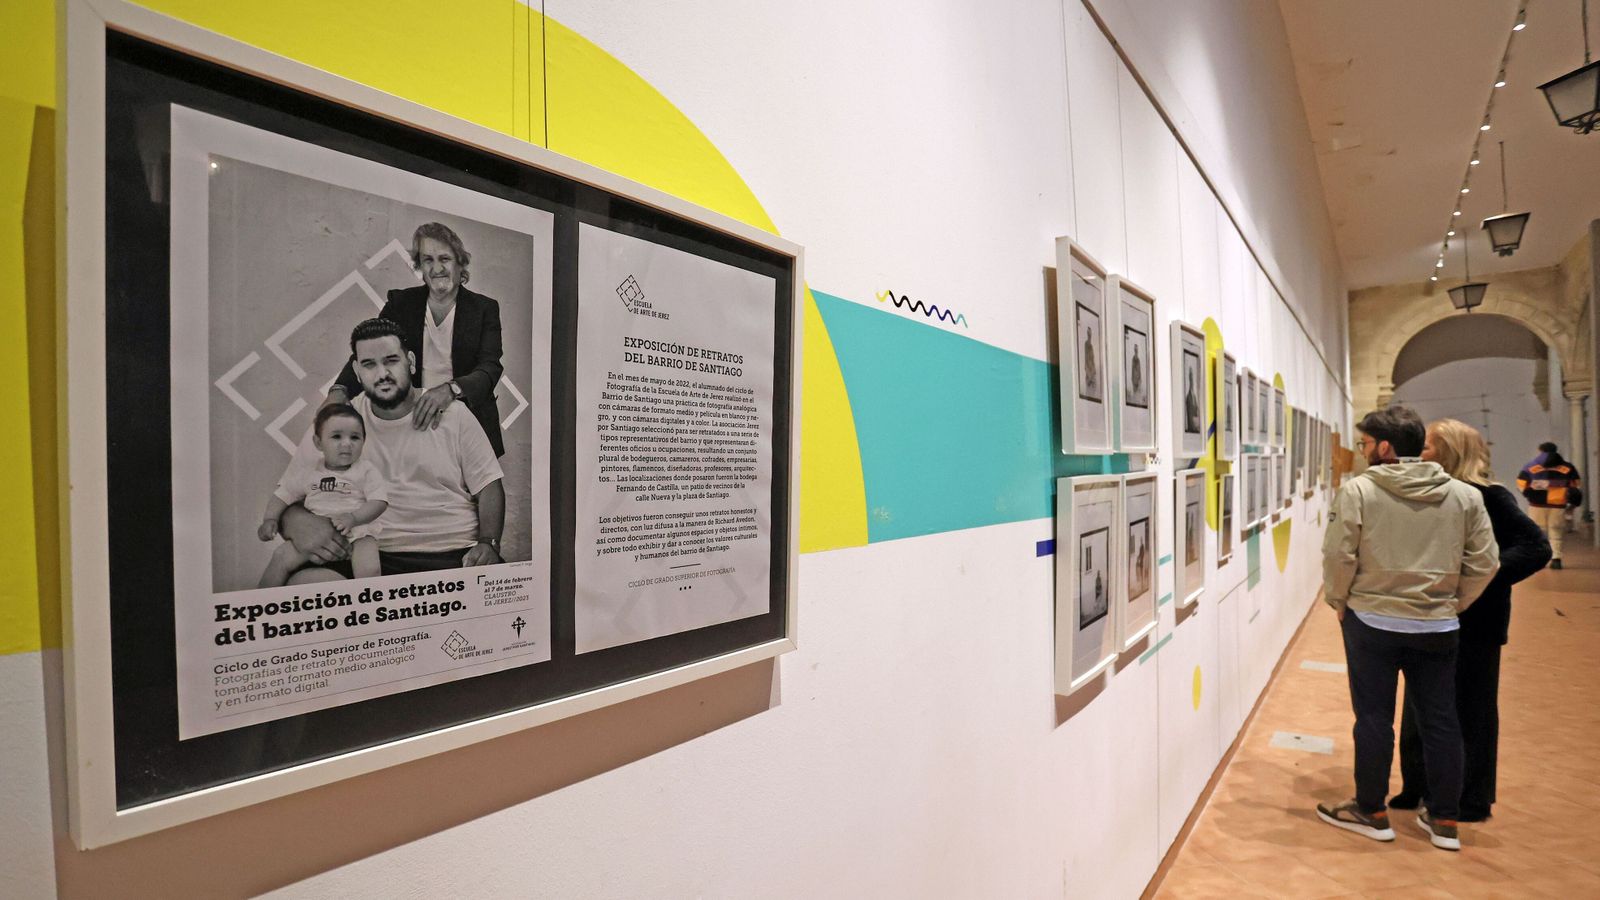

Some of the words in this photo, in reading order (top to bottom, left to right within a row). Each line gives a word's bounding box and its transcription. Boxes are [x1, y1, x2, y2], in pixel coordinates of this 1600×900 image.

[634, 299, 652, 309] ESCUELA
[633, 307, 639, 315] DE
[640, 308, 651, 317] ARTE
[651, 310, 657, 318] DE
[657, 312, 670, 320] JEREZ
[624, 336, 685, 355] EXPOSICIÓN
[686, 346, 699, 358] DE
[700, 349, 743, 365] RETRATOS
[624, 352, 646, 364] DEL
[647, 354, 684, 369] BARRIO
[685, 360, 698, 371] DE
[698, 362, 743, 377] SANTIAGO
[608, 372, 617, 380] En
[617, 373, 624, 381] el
[640, 375, 649, 383] de
[649, 378, 667, 386] mayo
[667, 378, 675, 386] de
[692, 381, 698, 389] el
[642, 385, 650, 393] de
[650, 386, 657, 394] la
[658, 387, 680, 396] Escuela
[689, 390, 701, 398] Arte
[602, 391, 623, 401] Barrio
[624, 394, 633, 402] de
[634, 394, 662, 405] Santiago
[662, 398, 674, 406] una
[642, 405, 650, 413] de
[650, 406, 675, 415] formato
[597, 414, 611, 422] gro,
[660, 416, 686, 426] digitales
[597, 424, 609, 432] por
[610, 423, 640, 434] Santiago
[675, 428, 688, 436] para
[600, 433, 619, 443] tipos
[619, 435, 669, 444] representativos
[669, 436, 679, 444] del
[679, 436, 698, 444] barrio
[702, 438, 713, 446] que
[600, 444, 629, 452] ferentes
[629, 445, 652, 453] oficios
[598, 454, 620, 464] plural
[620, 454, 629, 462] de
[600, 464, 631, 474] pintores,
[598, 475, 616, 483] tos...
[616, 474, 628, 482] Las
[628, 474, 672, 482] localizaciones
[616, 484, 647, 492] Fernando
[647, 484, 656, 492] de
[690, 483, 705, 492] patio
[635, 494, 650, 502] calle
[650, 493, 671, 501] Nueva
[682, 492, 698, 501] plaza
[599, 516, 611, 524] Los
[612, 515, 642, 524] objetivos
[664, 512, 694, 520] conseguir
[600, 526, 629, 534] directos,
[643, 523, 654, 531] luz
[654, 522, 674, 530] difusa
[596, 536, 606, 545] así
[607, 536, 626, 544] como
[627, 532, 666, 543] documentar
[666, 531, 690, 539] algunos
[690, 528, 714, 537] espacios
[596, 548, 602, 557] y
[602, 546, 622, 555] sobre
[622, 544, 638, 552] todo
[638, 542, 661, 551] exhibir
[666, 540, 677, 548] dar
[682, 538, 706, 546] conocer
[639, 551, 669, 560] humanos
[670, 549, 680, 557] del
[680, 547, 698, 556] barrio
[628, 579, 646, 588] CICLO
[646, 578, 654, 586] DE
[654, 575, 674, 584] GRADO
[674, 572, 699, 582] SUPERIOR
[699, 570, 706, 578] DE
[214, 591, 353, 623] Exposición
[358, 587, 384, 604] de
[388, 580, 465, 600] retratos
[214, 624, 256, 646] del
[262, 615, 338, 639] barrio
[344, 610, 370, 627] de
[375, 600, 466, 622] Santiago.
[214, 662, 249, 675] Ciclo
[252, 658, 268, 668] de
[270, 652, 308, 665] Grado
[311, 644, 360, 659] Superior
[362, 640, 375, 650] de
[378, 631, 432, 647] Fotografía.
[458, 645, 476, 653] ESCUELA
[214, 665, 283, 686] Fotografías
[284, 664, 299, 674] de
[301, 658, 337, 671] retrato
[338, 656, 346, 665] y
[347, 644, 416, 663] documentales
[214, 681, 267, 698] tomadas
[269, 678, 285, 687] en
[288, 669, 332, 684] formato
[334, 663, 367, 675] medio
[368, 653, 415, 669] analógico
[214, 700, 223, 711] y
[224, 697, 242, 707] en
[244, 687, 292, 703] formato
[294, 678, 329, 693] digital
